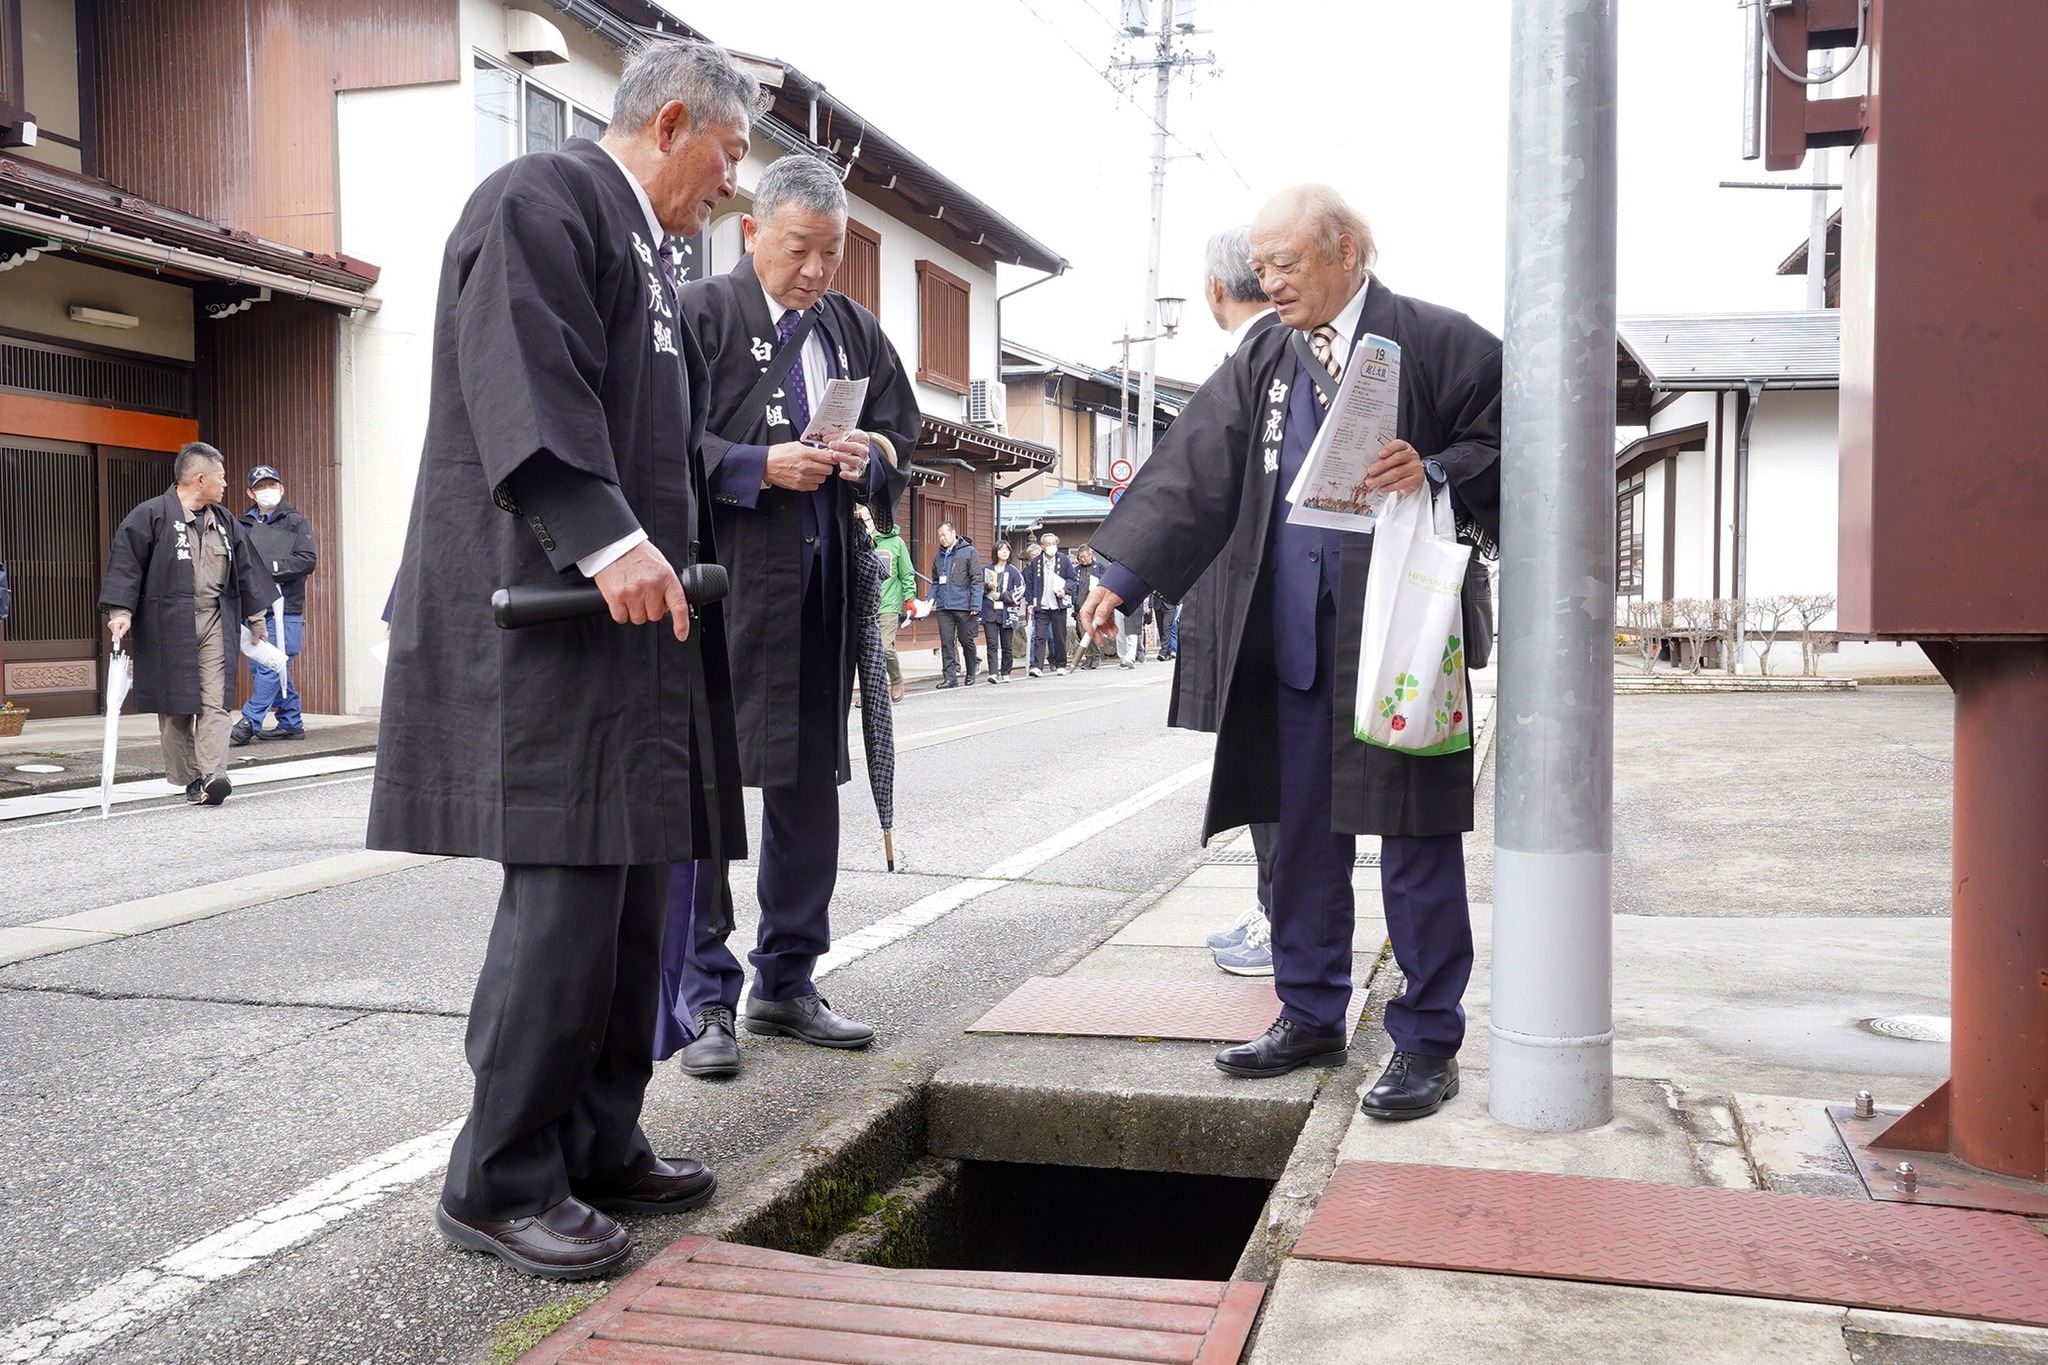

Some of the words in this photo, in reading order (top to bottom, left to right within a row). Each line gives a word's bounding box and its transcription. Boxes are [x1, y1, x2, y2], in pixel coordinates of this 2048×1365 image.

[631, 231, 678, 356] 白虎組
[751, 337, 790, 427] 白組
[1261, 378, 1289, 475] 白虎組
[1114, 465, 1128, 477] 30
[173, 520, 192, 561] 白虎組
